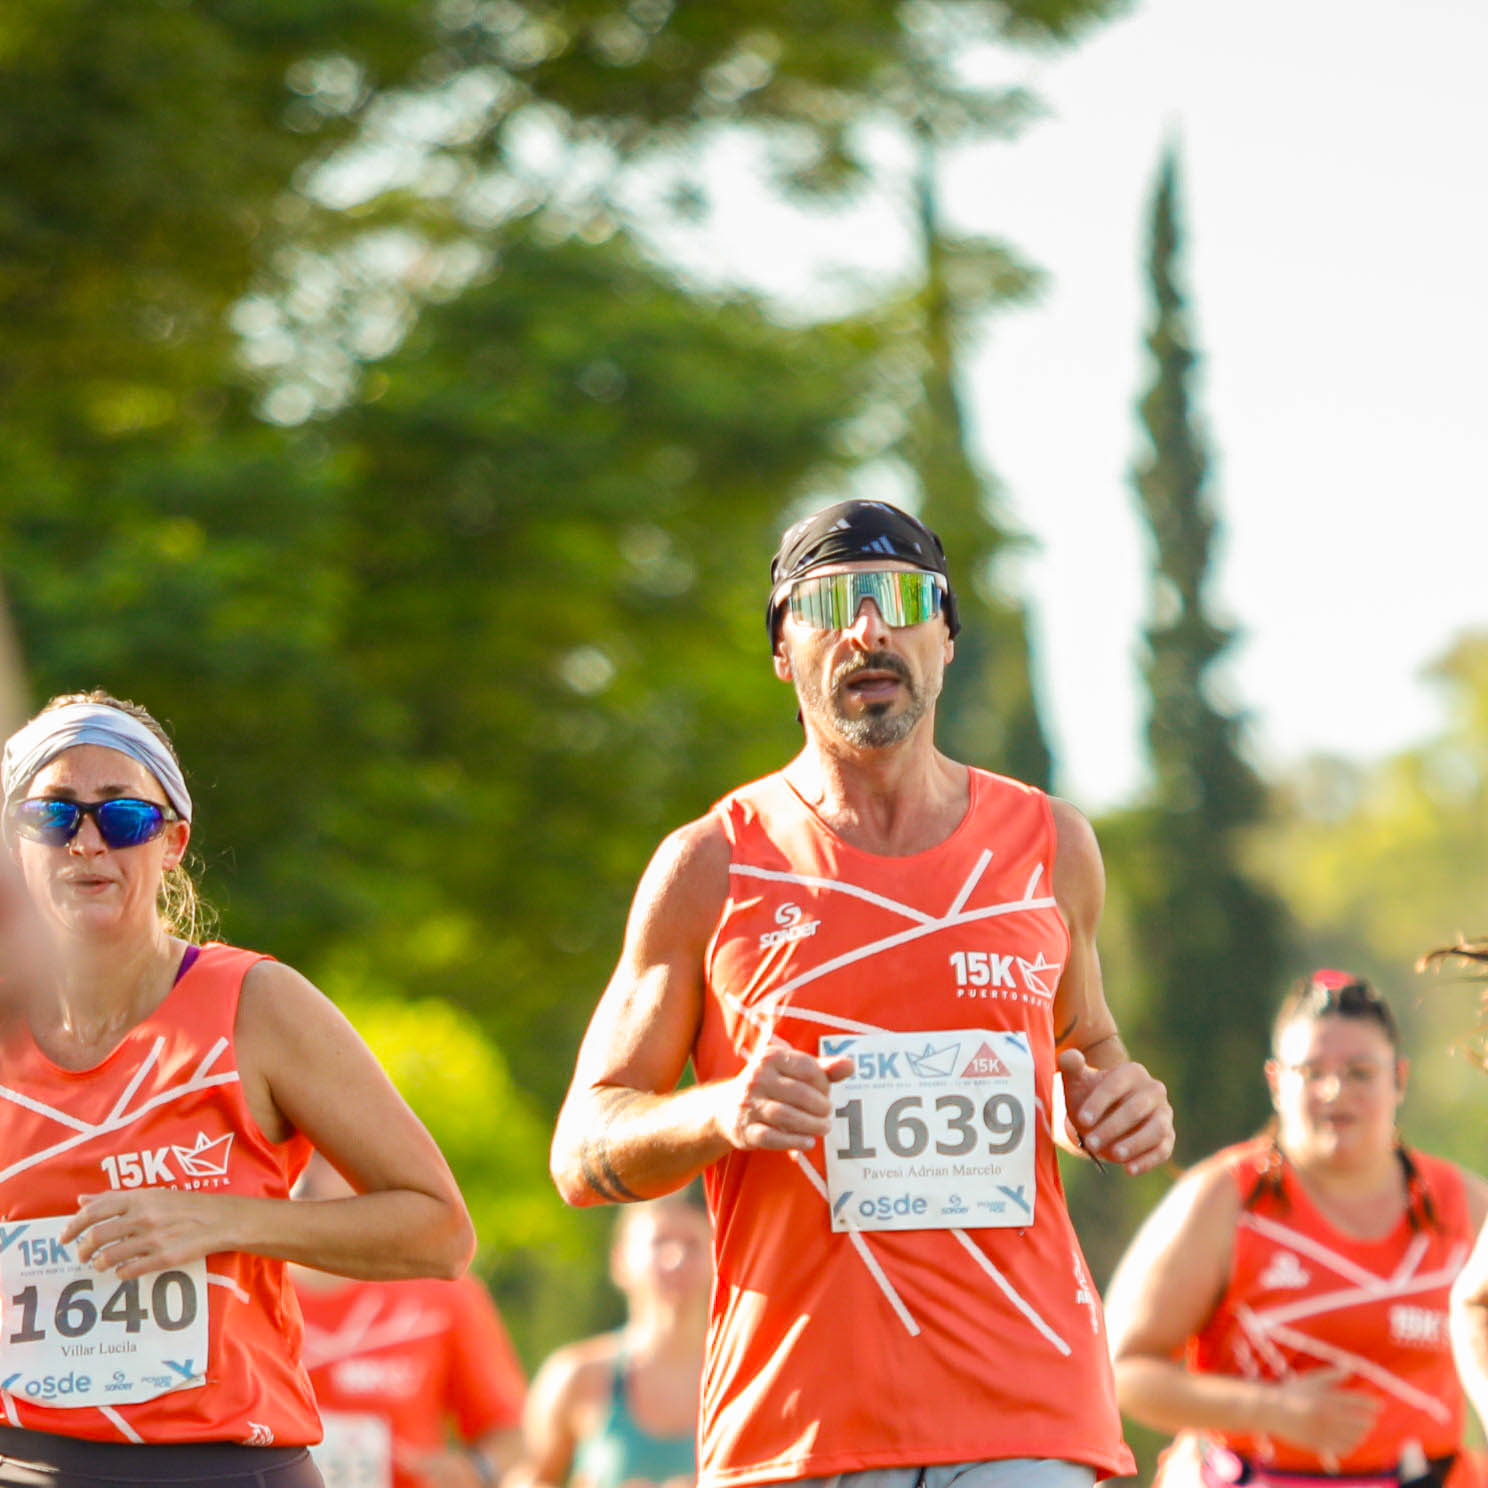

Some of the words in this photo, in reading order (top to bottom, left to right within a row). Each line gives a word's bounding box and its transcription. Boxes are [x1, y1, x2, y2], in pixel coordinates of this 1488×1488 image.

[949, 951, 1017, 988] 15K
[956, 988, 1018, 1001] PUERTO
[972, 1058, 1001, 1074] 15K
[834, 1093, 1027, 1160] 1639
[100, 1146, 177, 1190] 15K
[863, 1167, 903, 1180] Pavesi
[908, 1165, 949, 1178] Adrian
[952, 1164, 1002, 1177] Marcelo
[858, 1192, 928, 1217] osde
[18, 1237, 72, 1268] 15K
[8, 1269, 199, 1345] 1640
[60, 1342, 96, 1358] Villar
[99, 1340, 137, 1355] Lucila
[24, 1371, 92, 1397] osde
